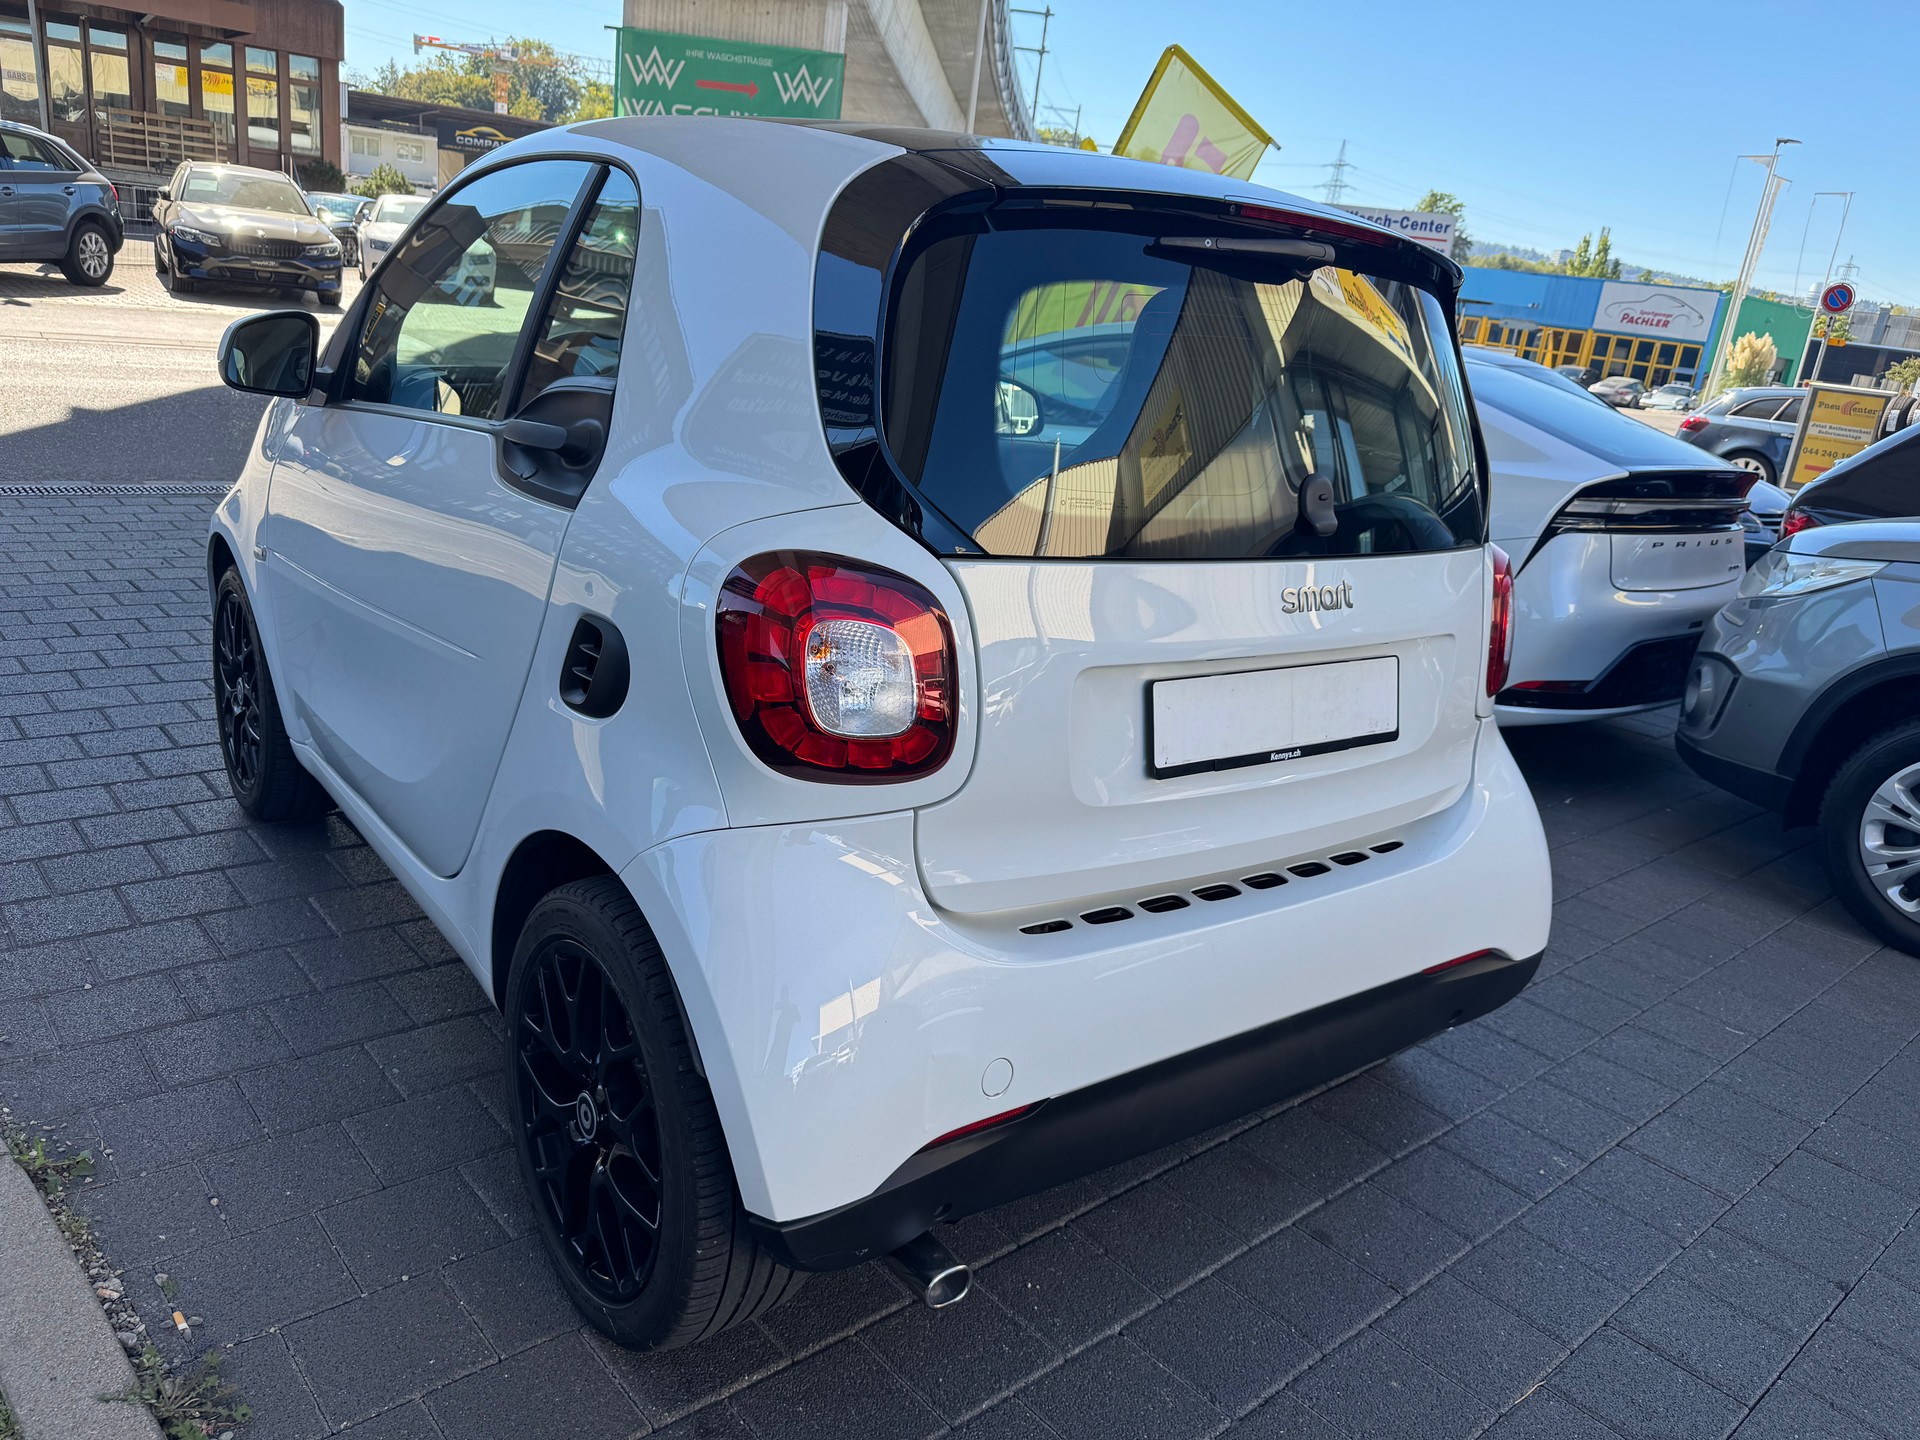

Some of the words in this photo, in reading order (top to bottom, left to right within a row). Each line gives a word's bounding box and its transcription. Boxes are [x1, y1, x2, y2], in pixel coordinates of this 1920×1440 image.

[685, 49, 704, 59] IHRE
[706, 51, 774, 67] WASCHSTRASSE
[7, 71, 27, 80] GABS
[1620, 313, 1670, 328] PACHLER
[1802, 447, 1819, 456] 044
[1821, 450, 1838, 459] 240
[1652, 538, 1733, 549] PRIUS
[1281, 579, 1354, 614] smart
[1270, 749, 1302, 761] Kennys.ch
